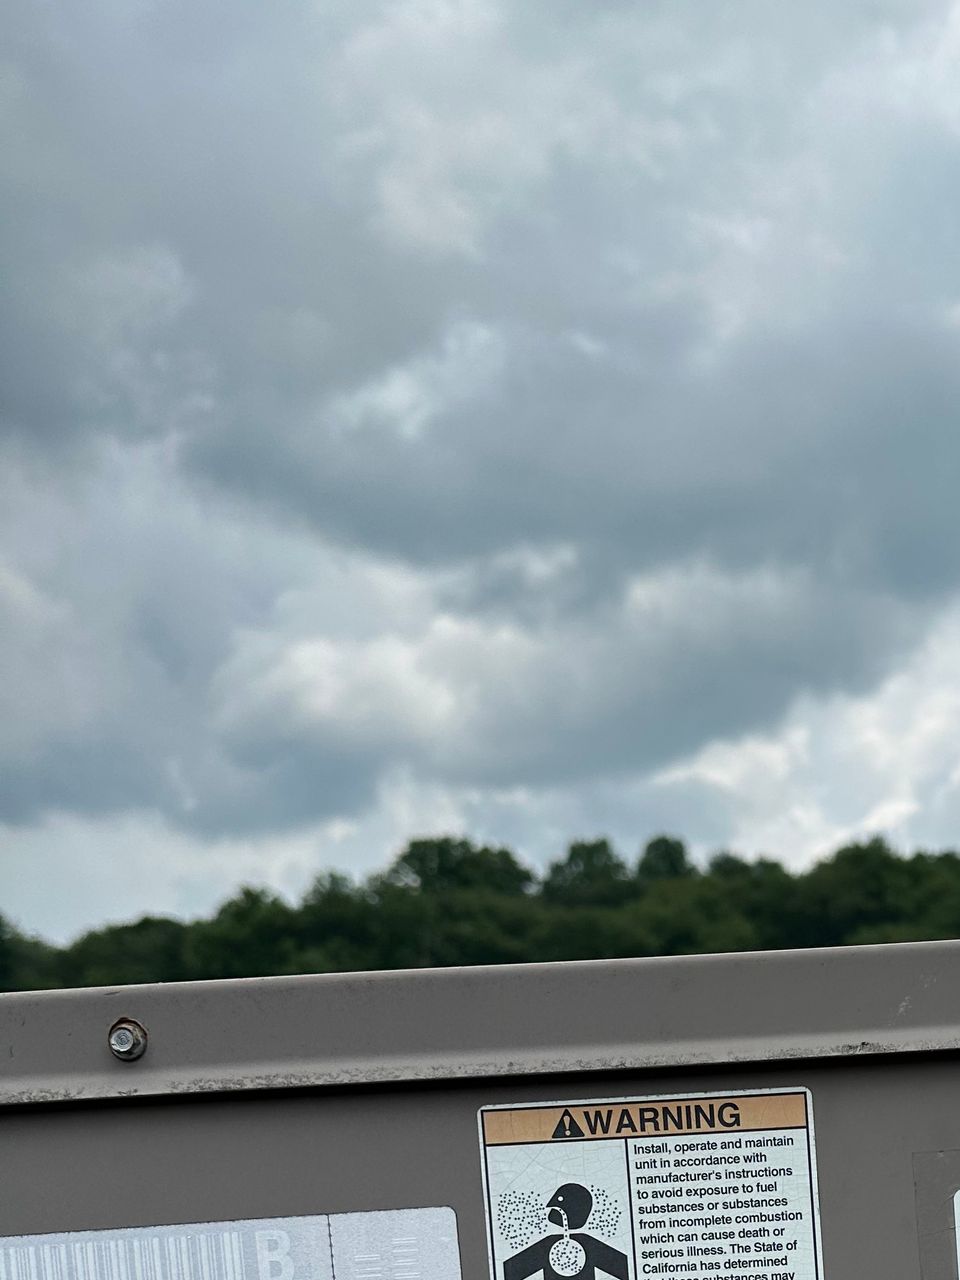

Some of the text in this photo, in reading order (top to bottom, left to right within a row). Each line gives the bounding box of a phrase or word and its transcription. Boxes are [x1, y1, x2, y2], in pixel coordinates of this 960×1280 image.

[585, 1102, 741, 1135] WARNING
[633, 1135, 794, 1155] Install, operate and maintain
[634, 1151, 767, 1170] unit in accordance with
[635, 1166, 793, 1185] manufacturer's instructions
[636, 1180, 778, 1200] to avoid exposure to fuel
[638, 1197, 788, 1215] substances or substances
[638, 1210, 803, 1230] from incomplete combustion
[639, 1226, 786, 1245] which can cause death or
[641, 1239, 798, 1260] serious illness. The State of
[642, 1255, 788, 1275] California has determined
